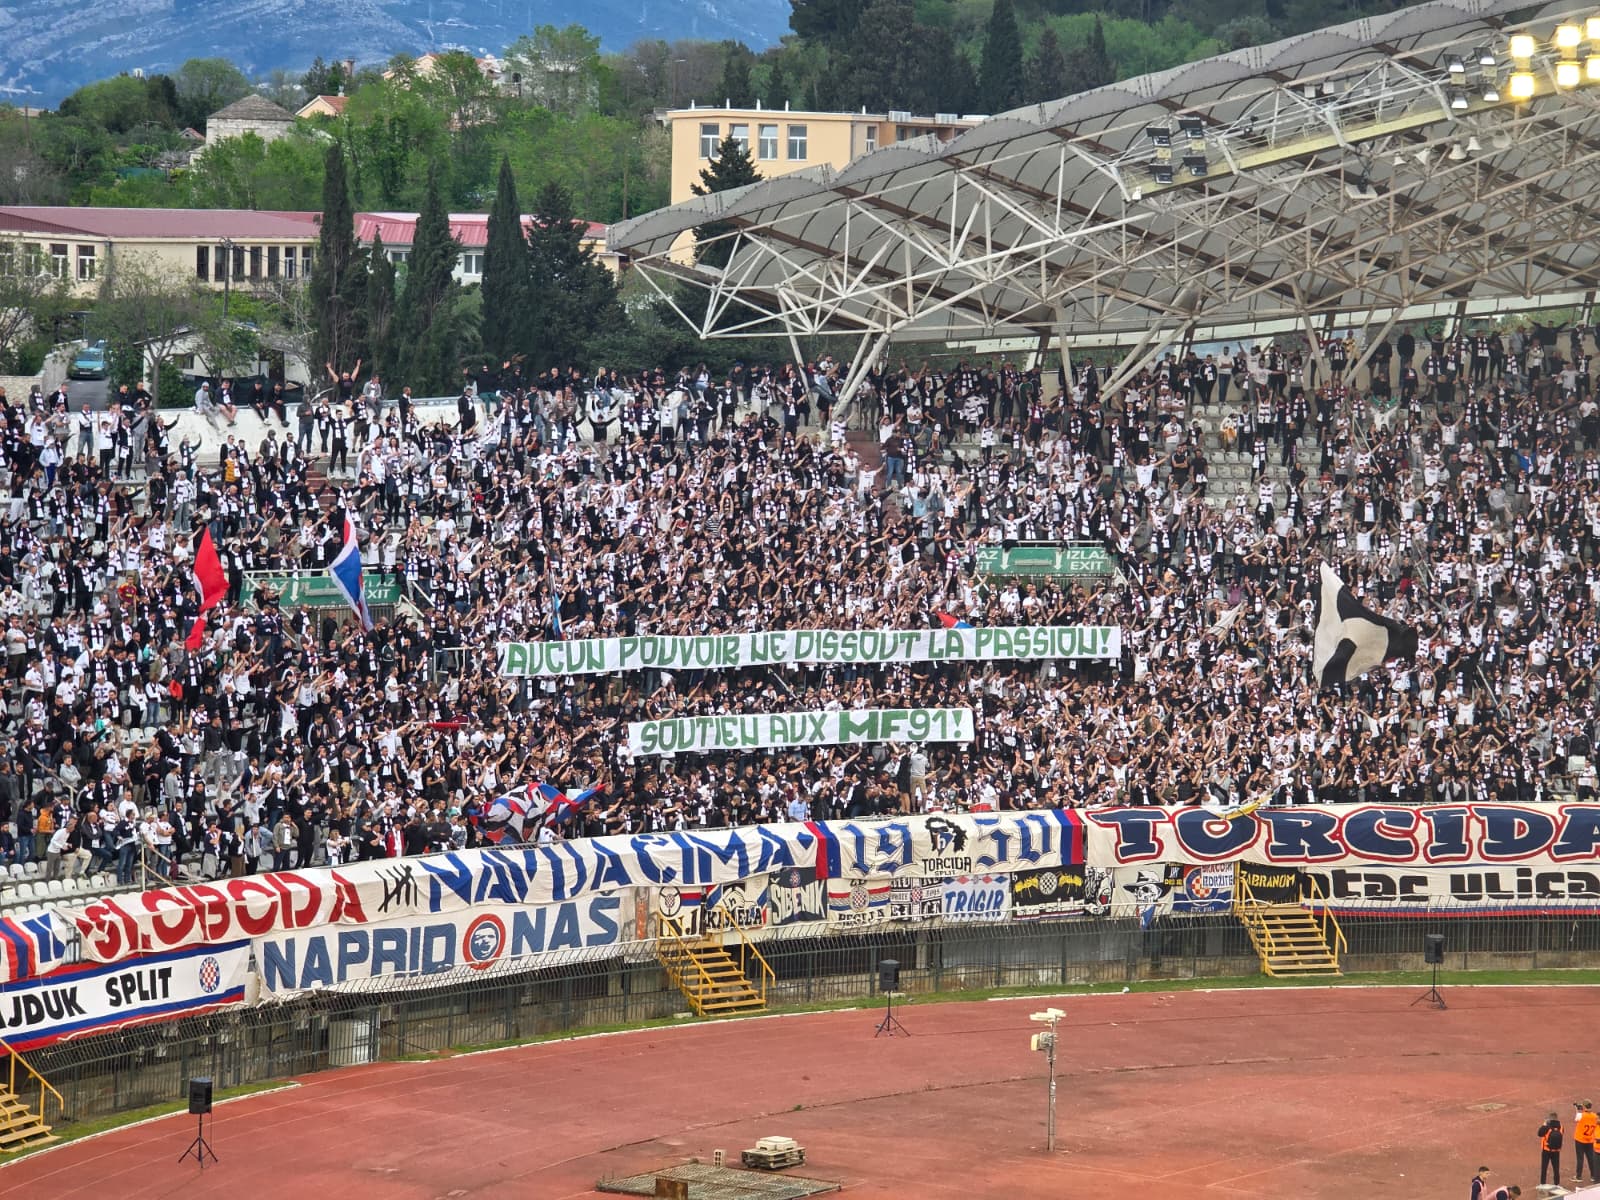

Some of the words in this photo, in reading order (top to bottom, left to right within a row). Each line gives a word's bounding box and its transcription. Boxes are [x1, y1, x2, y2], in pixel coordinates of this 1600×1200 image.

[1070, 562, 1103, 571] EXIT
[368, 589, 391, 598] XIT
[506, 640, 605, 675] AUCUN
[619, 635, 740, 668] POUVOIR
[750, 633, 787, 662] NE
[795, 630, 921, 661] DISSOUT
[928, 629, 964, 659] LA
[975, 627, 1111, 657] PASSION!
[640, 716, 758, 754] SOUTIEN
[769, 713, 827, 744] AUX
[838, 709, 962, 743] MF91!
[922, 856, 972, 876] TORCIDA
[76, 869, 368, 960] SLOBODA
[769, 877, 828, 925] ŠIBENIK
[263, 922, 457, 993] NAPRID
[511, 889, 621, 960] NAŠ
[106, 966, 173, 1007] SPLIT
